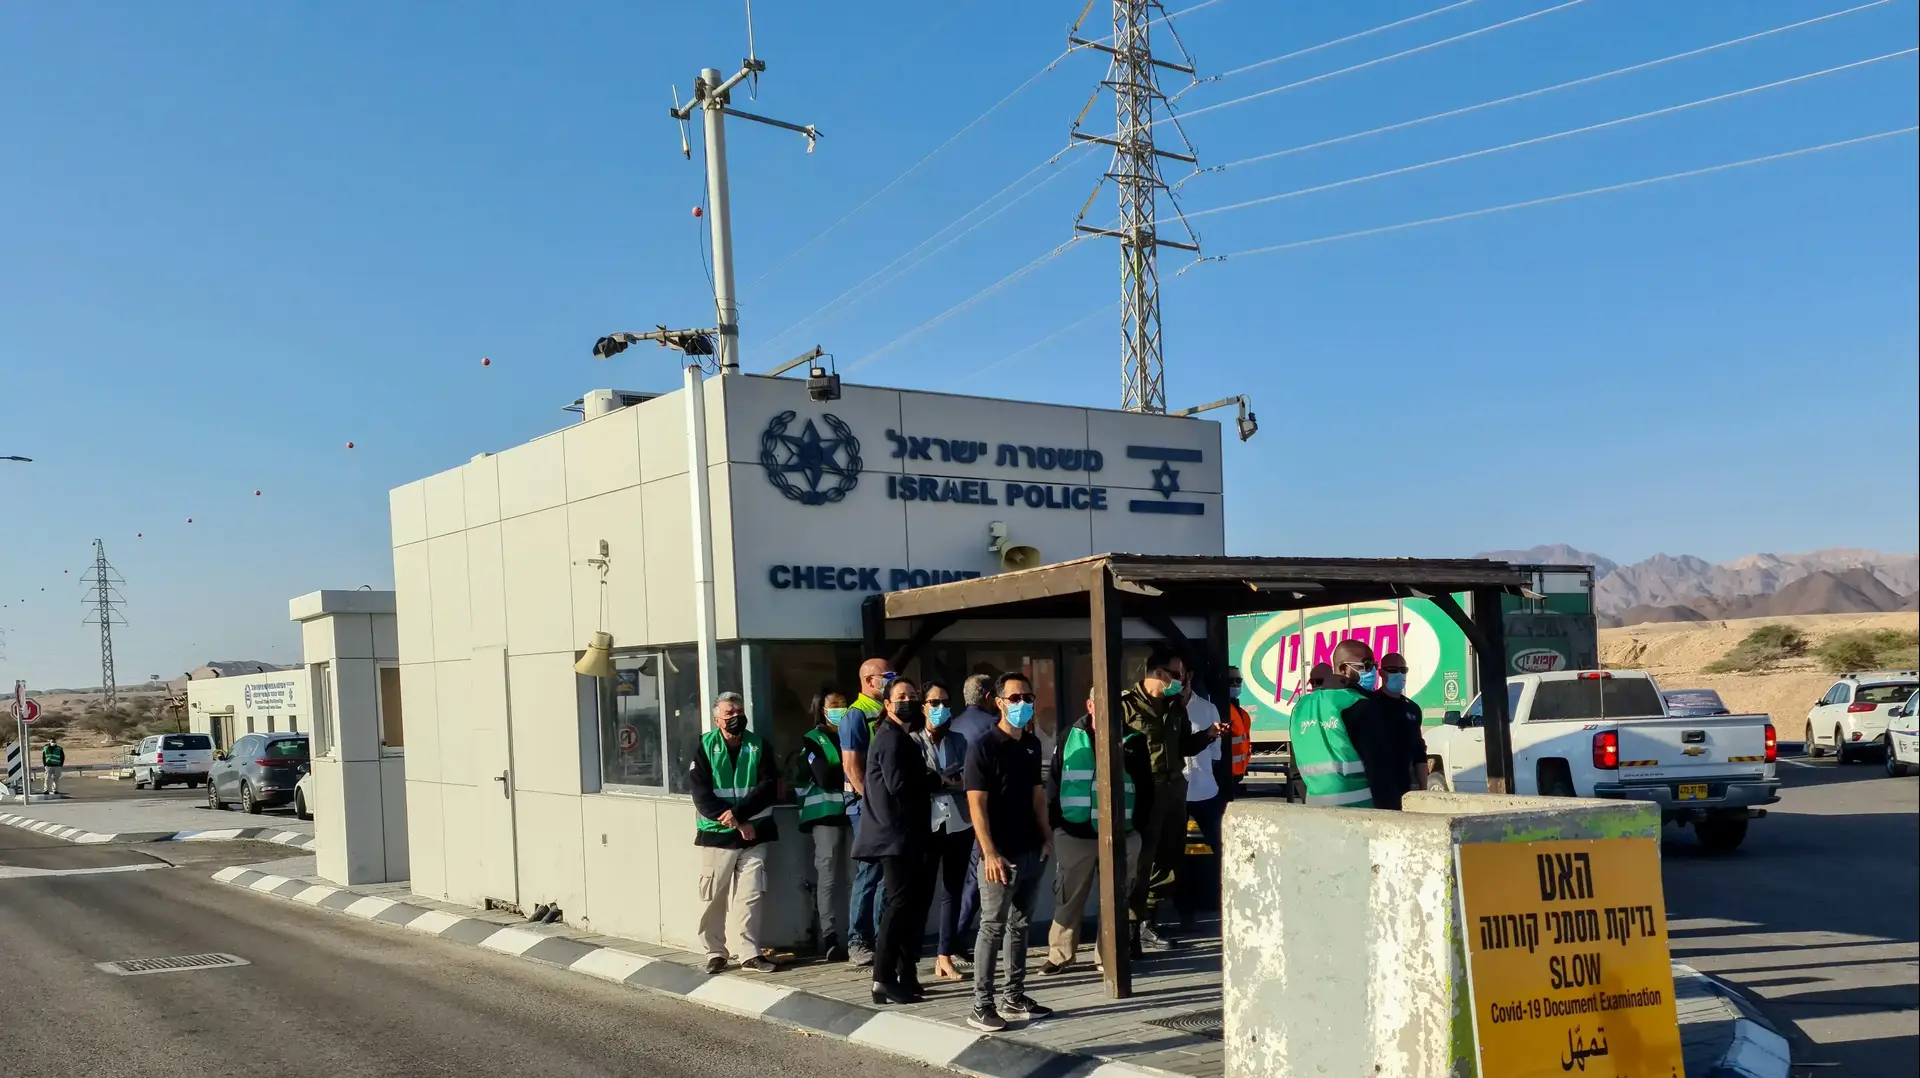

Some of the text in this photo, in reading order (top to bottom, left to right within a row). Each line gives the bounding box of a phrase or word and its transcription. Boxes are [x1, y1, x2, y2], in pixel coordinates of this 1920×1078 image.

[885, 428, 1104, 472] משטרת ישראל
[886, 475, 1109, 510] ISRAEL POLICE
[769, 563, 981, 591] CHECK POIN
[1536, 852, 1594, 902] האט
[1479, 905, 1656, 954] בדיקת מסמכי קורונה
[1549, 952, 1601, 990] SLOW
[1491, 986, 1662, 1024] Covid-19 Document Examination
